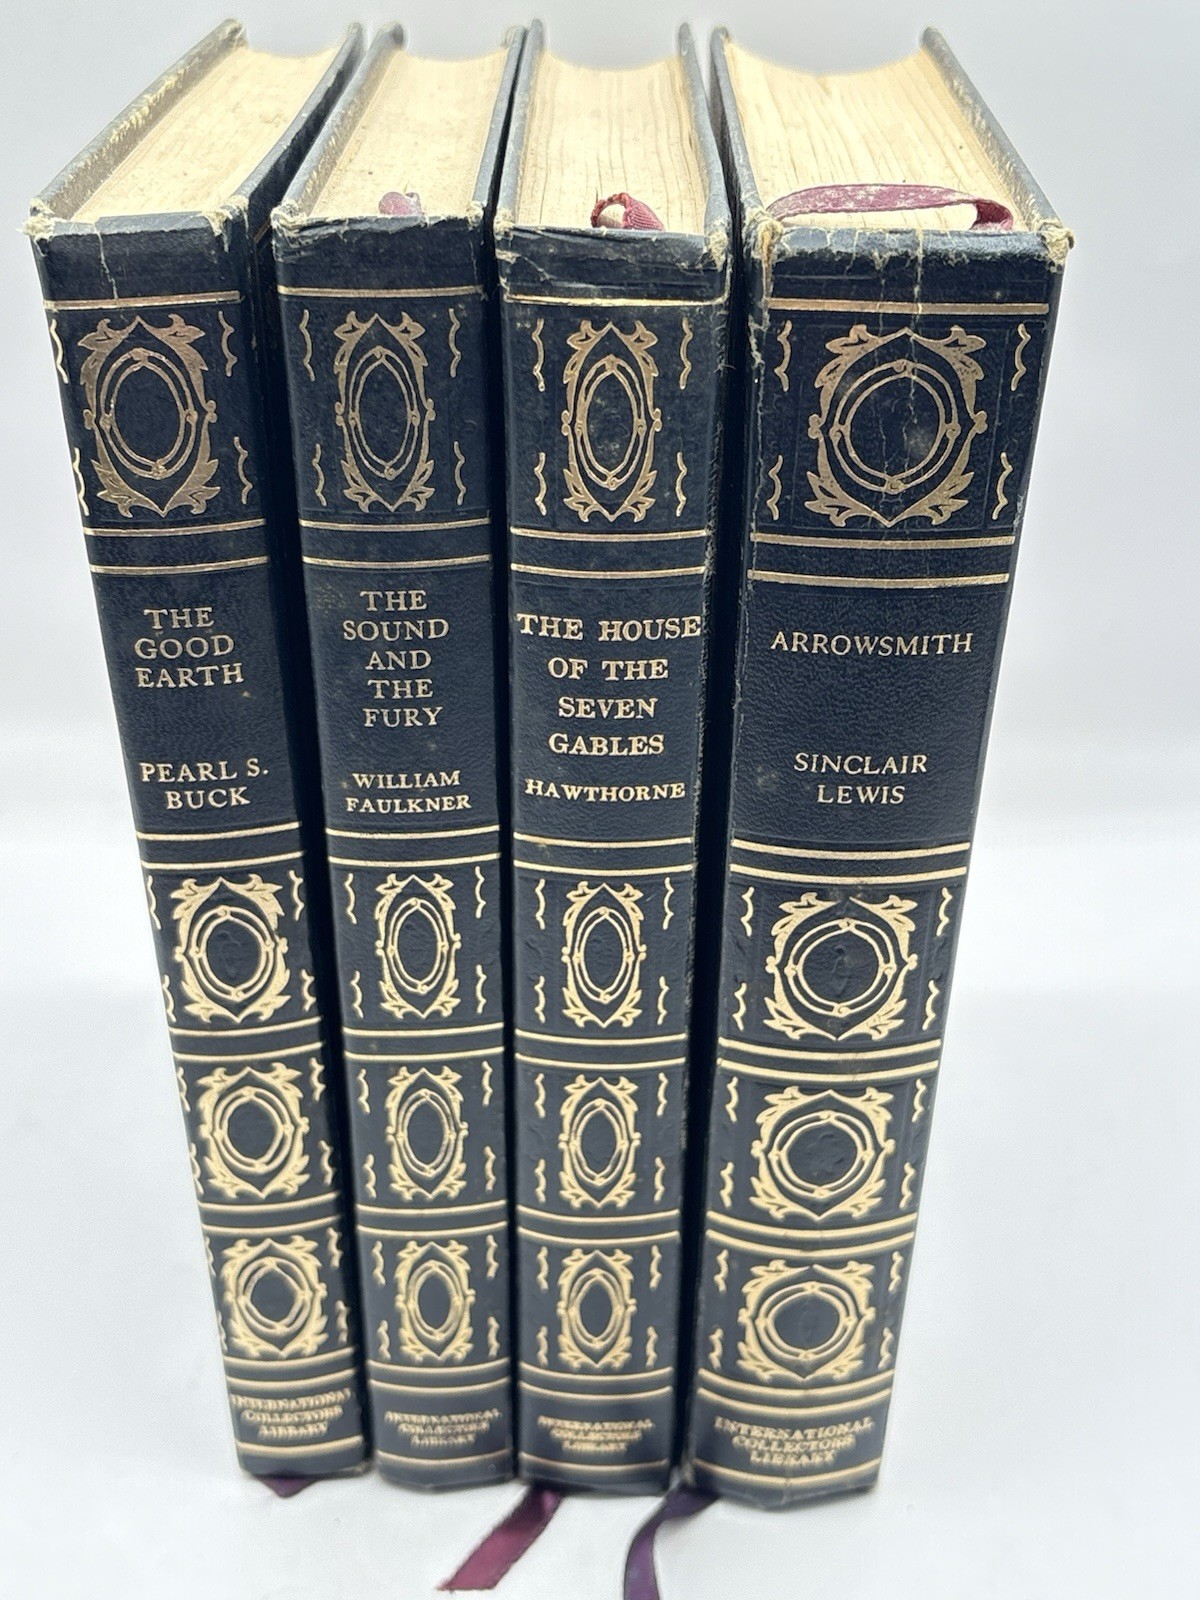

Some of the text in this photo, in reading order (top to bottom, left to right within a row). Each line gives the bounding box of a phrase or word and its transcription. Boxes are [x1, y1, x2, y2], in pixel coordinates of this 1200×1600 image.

[360, 589, 428, 612] THE
[143, 606, 214, 630] THE
[342, 618, 450, 642] SOUND
[516, 613, 703, 643] THE HOUSE
[134, 634, 235, 660] GOOD
[770, 630, 974, 658] ARROWSMITH
[365, 649, 432, 671] AND
[547, 657, 670, 682] OF THE
[135, 662, 244, 688] EARTH
[367, 678, 434, 700] THE
[363, 706, 444, 728] FURY
[557, 697, 659, 721] SEVEN
[548, 733, 666, 759] GABLES
[139, 757, 270, 784] PEARL S.
[793, 752, 929, 777] SINCLAIR
[352, 769, 462, 790] WILLIAM
[524, 777, 688, 804] HAWTHORNE
[165, 786, 251, 811] BUCK
[345, 794, 473, 814] FAULKNER
[816, 784, 906, 806] LEWIS
[714, 1416, 873, 1440] INTERNATIONAL
